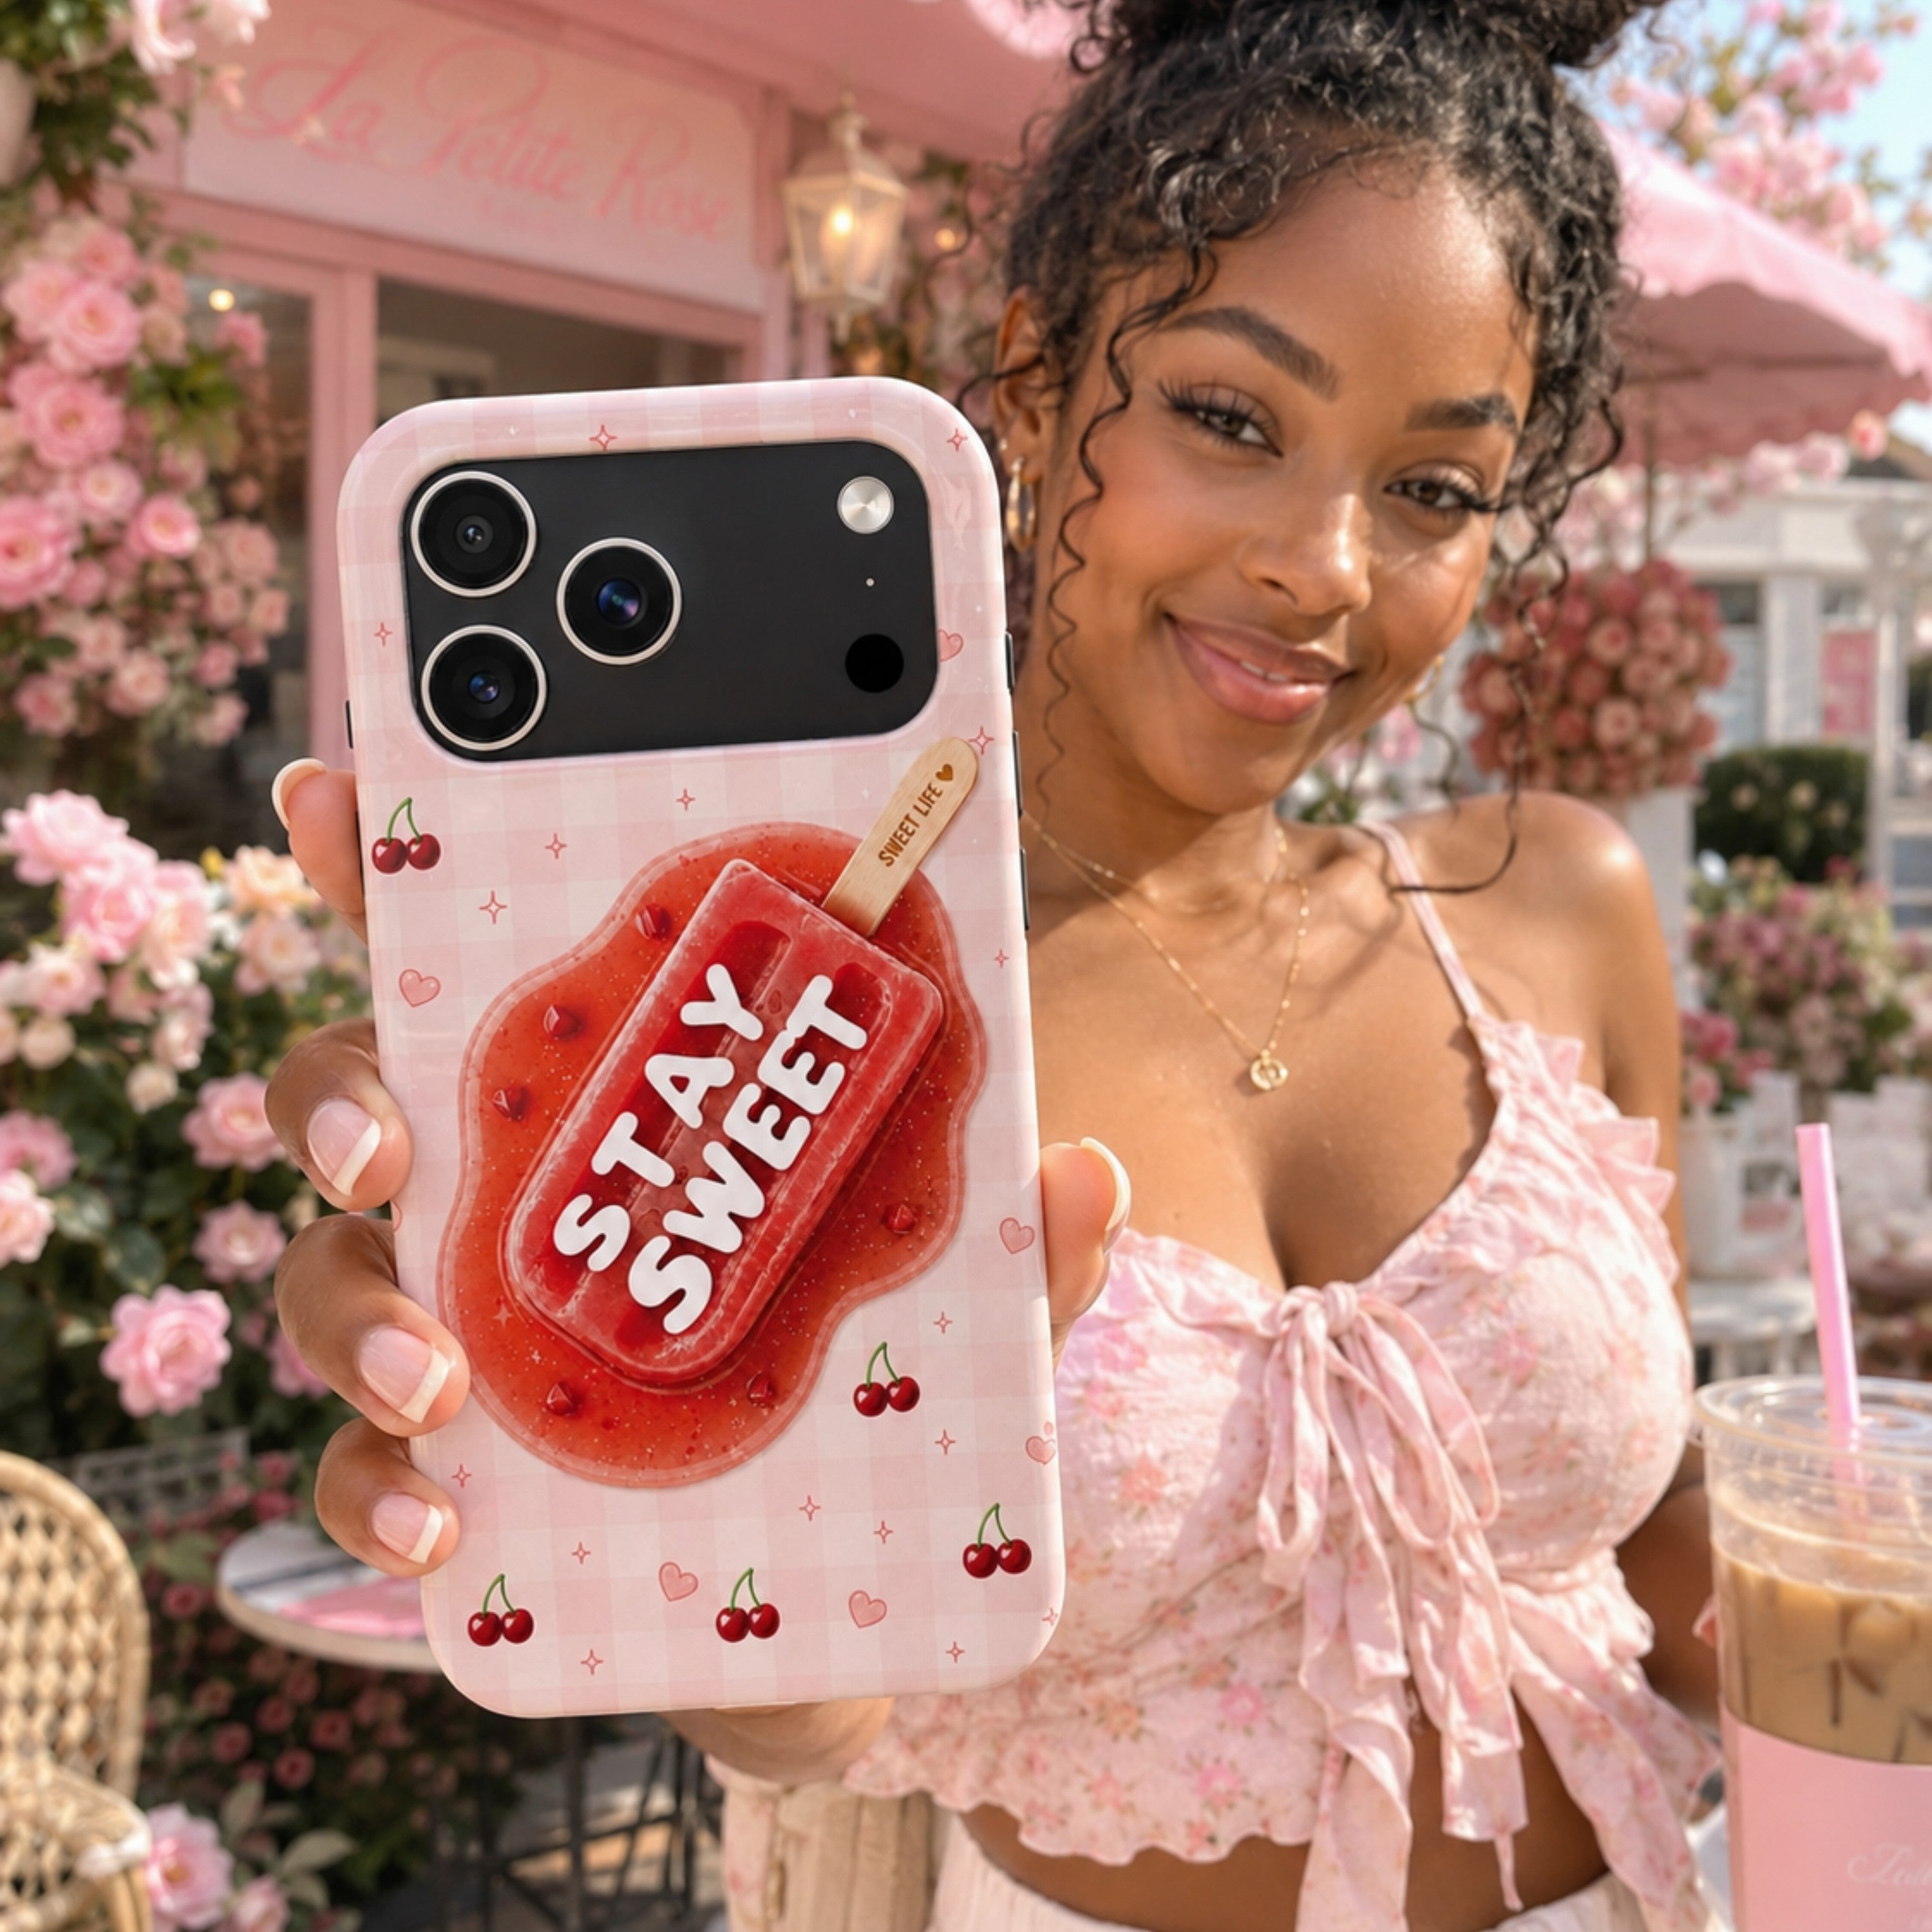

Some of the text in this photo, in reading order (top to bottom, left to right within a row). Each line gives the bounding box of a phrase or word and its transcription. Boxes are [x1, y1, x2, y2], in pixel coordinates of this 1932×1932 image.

[221, 18, 732, 242] La Petite Rose
[878, 782, 943, 867] SWEET LIFE
[553, 963, 764, 1272] STAY
[628, 974, 867, 1334] SWEET
